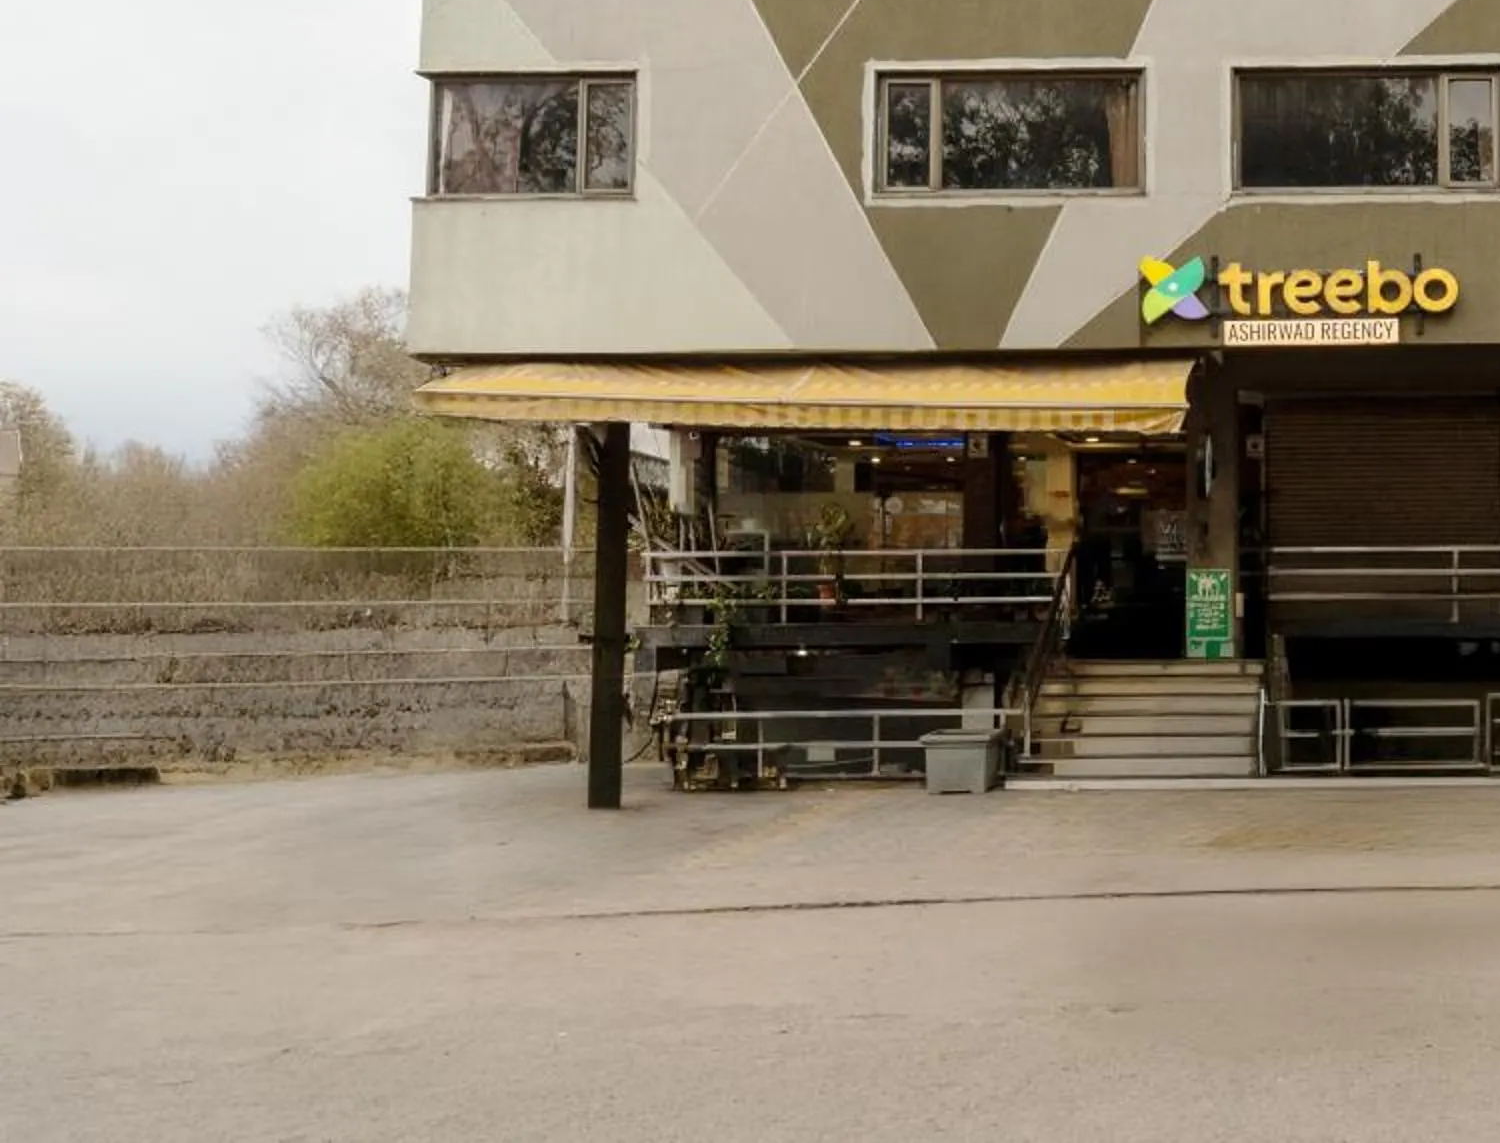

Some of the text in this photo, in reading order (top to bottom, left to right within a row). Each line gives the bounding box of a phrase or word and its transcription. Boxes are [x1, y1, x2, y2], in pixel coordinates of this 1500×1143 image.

[1218, 259, 1459, 315] treebo
[1228, 321, 1395, 342] ASHIRWAD REGENCY
